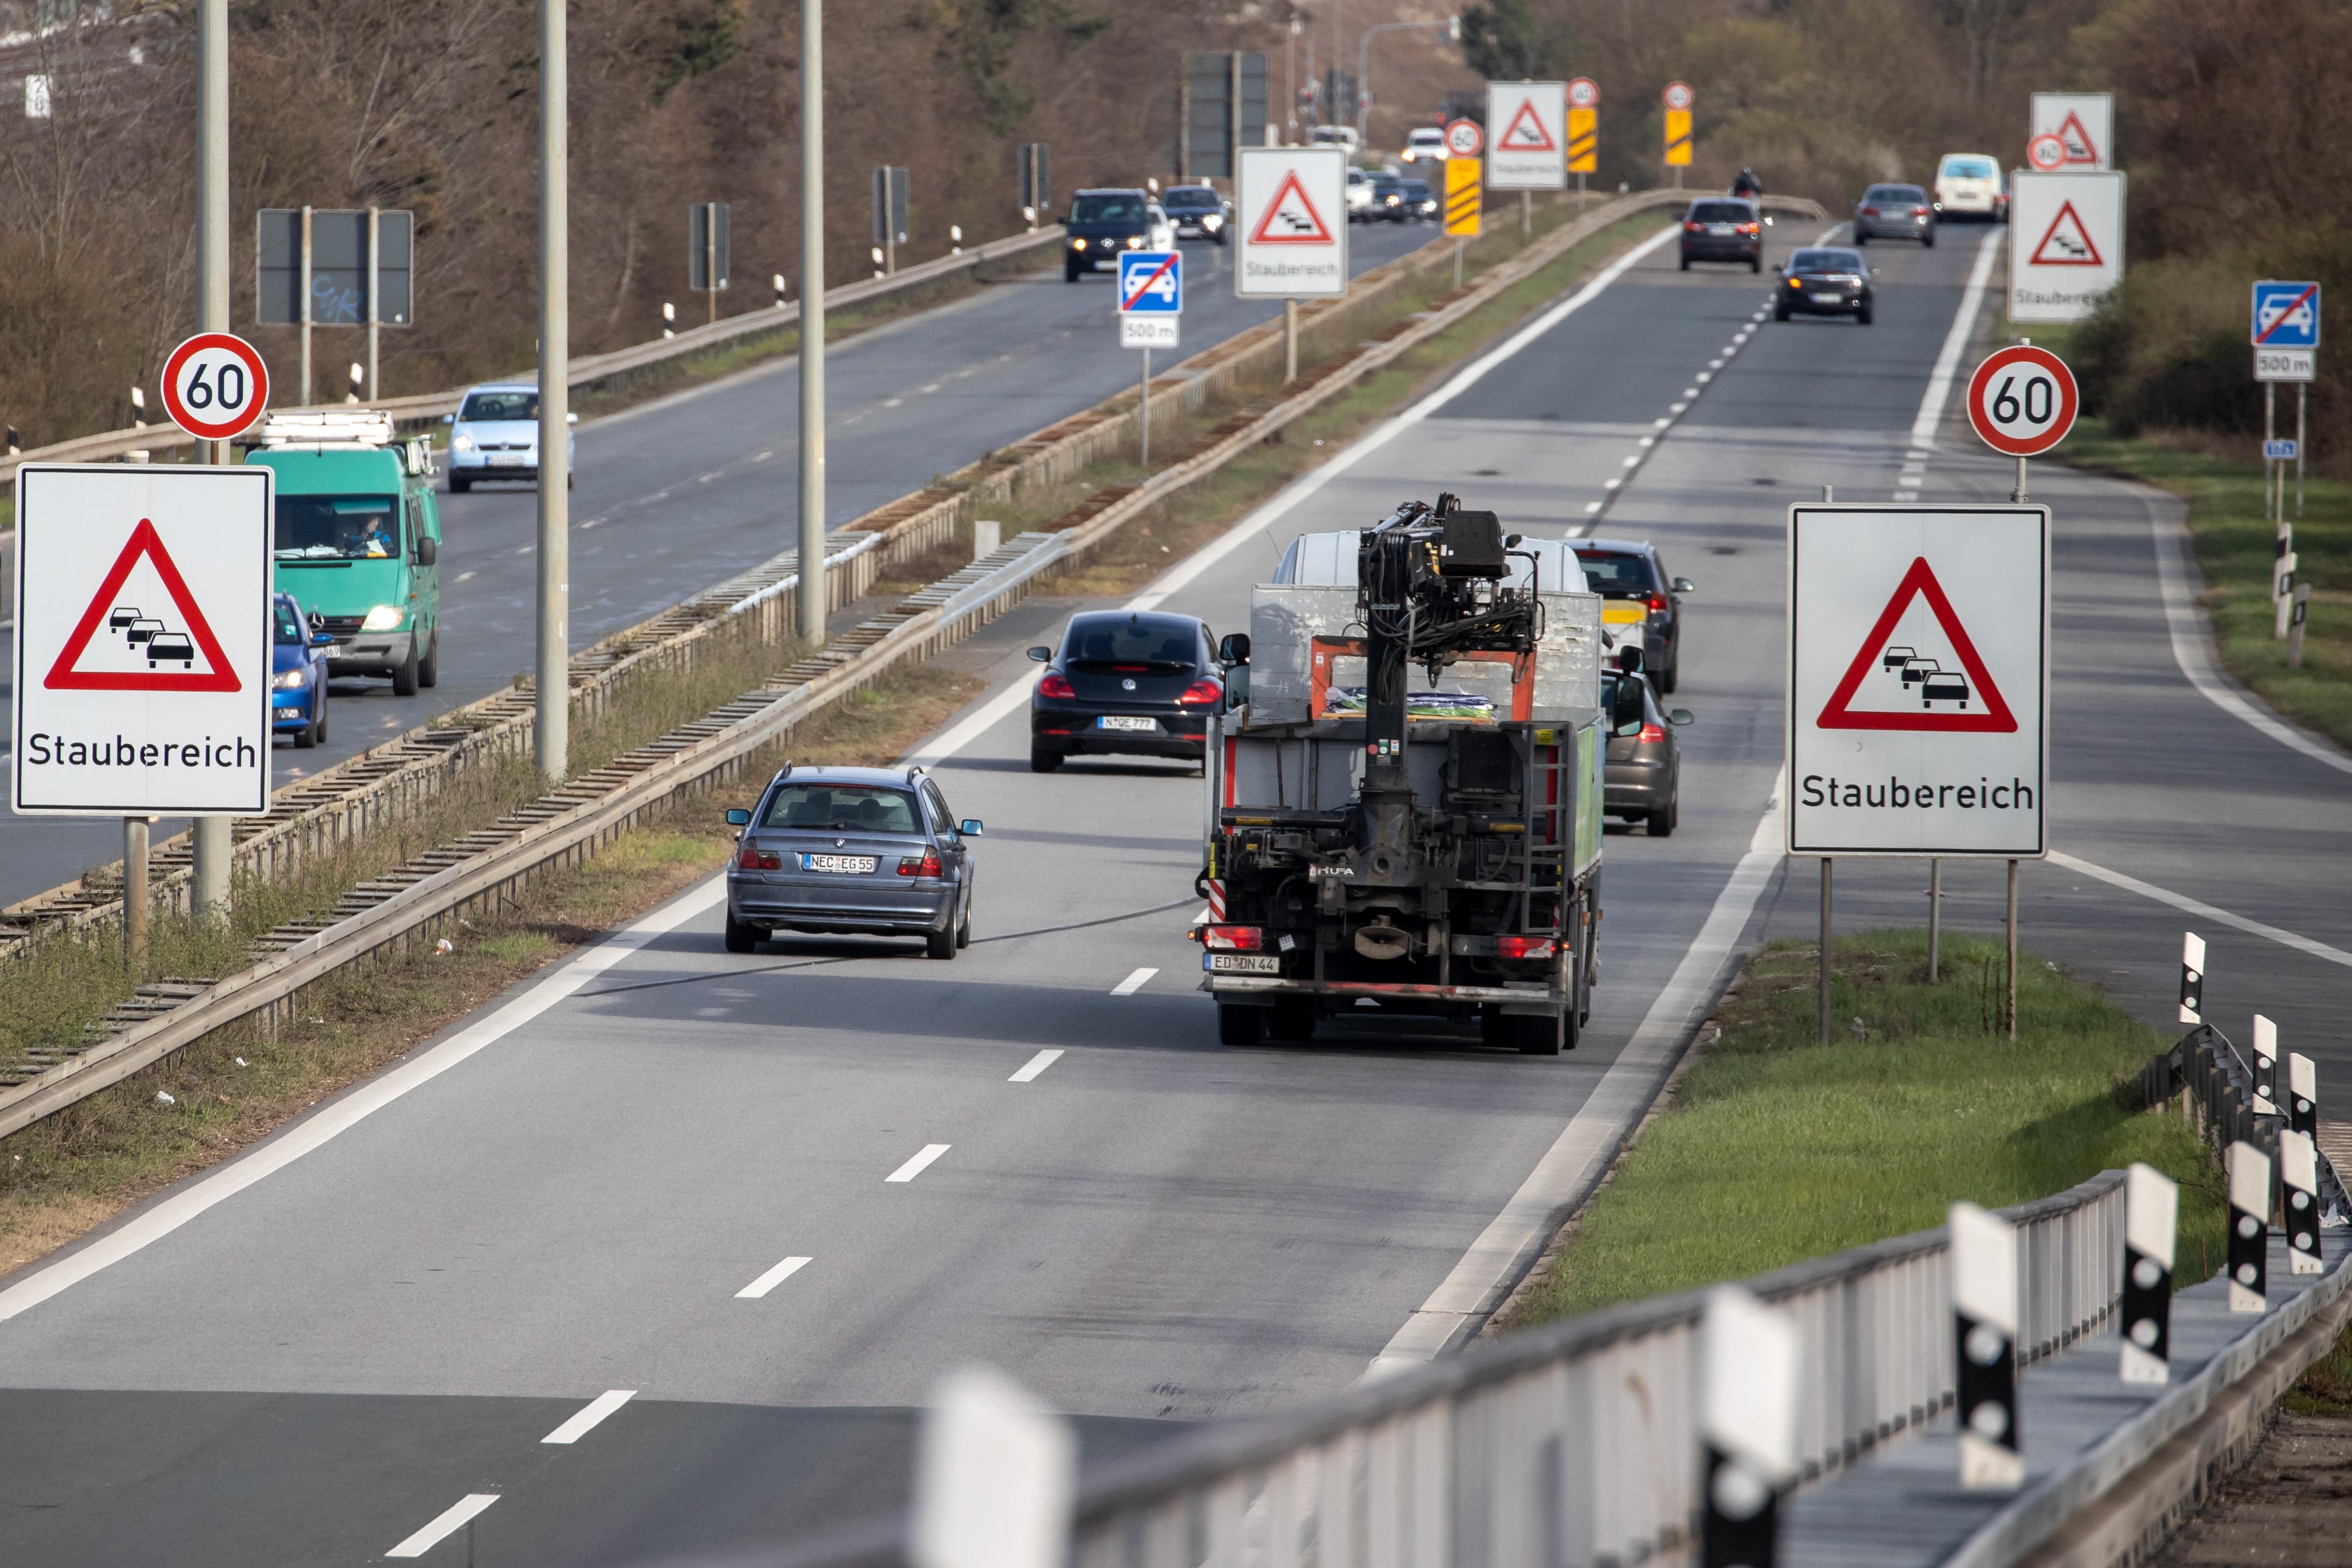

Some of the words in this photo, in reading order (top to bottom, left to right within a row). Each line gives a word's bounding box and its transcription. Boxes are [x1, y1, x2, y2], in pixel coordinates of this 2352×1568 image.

[1245, 260, 1339, 277] Staubereich
[1129, 323, 1156, 337] 500
[1158, 327, 1175, 337] m
[2259, 355, 2290, 372] 500
[2294, 360, 2309, 371] m
[187, 364, 243, 410] 60
[1993, 376, 2052, 424] 60
[28, 734, 255, 767] Staubereich
[1802, 775, 2033, 809] Staubereich
[811, 857, 833, 868] NEC
[842, 858, 856, 869] EG
[859, 859, 873, 869] 55
[1215, 956, 1231, 968] ED
[1240, 958, 1255, 969] DN
[1258, 959, 1273, 970] 44
